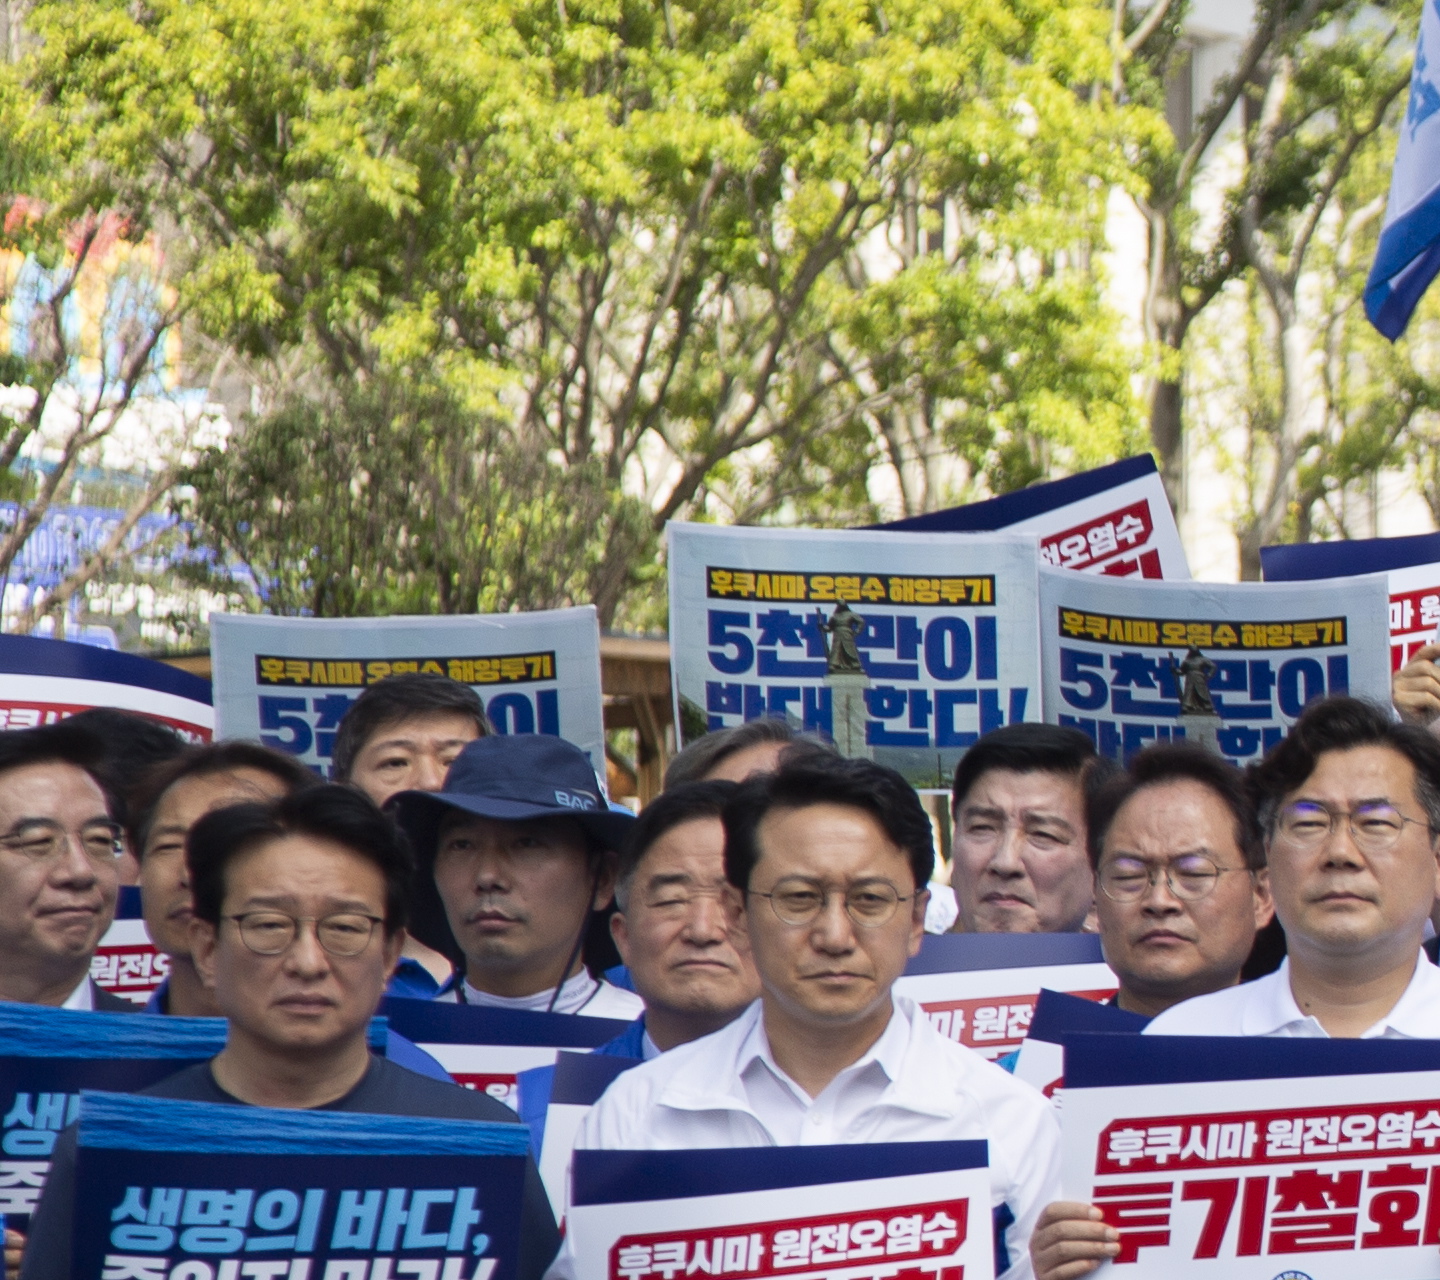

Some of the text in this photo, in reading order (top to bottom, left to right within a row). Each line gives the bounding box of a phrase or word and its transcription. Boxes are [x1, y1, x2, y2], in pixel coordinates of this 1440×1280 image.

[710, 571, 993, 604] 후쿠시마 오염수 해양투기
[707, 609, 997, 680] 5천만이
[1063, 611, 1343, 647] 후쿠시마 오염수 해양투기
[260, 658, 363, 683] 후쿠시마
[447, 656, 552, 679] 해양투기
[1059, 647, 1349, 718] 5천만이
[864, 688, 1028, 747] 한다!
[1107, 1120, 1257, 1165] 후쿠시마
[109, 1189, 327, 1251] 생명의
[344, 1186, 489, 1257] 바다,
[771, 1214, 957, 1266] 원전오염수
